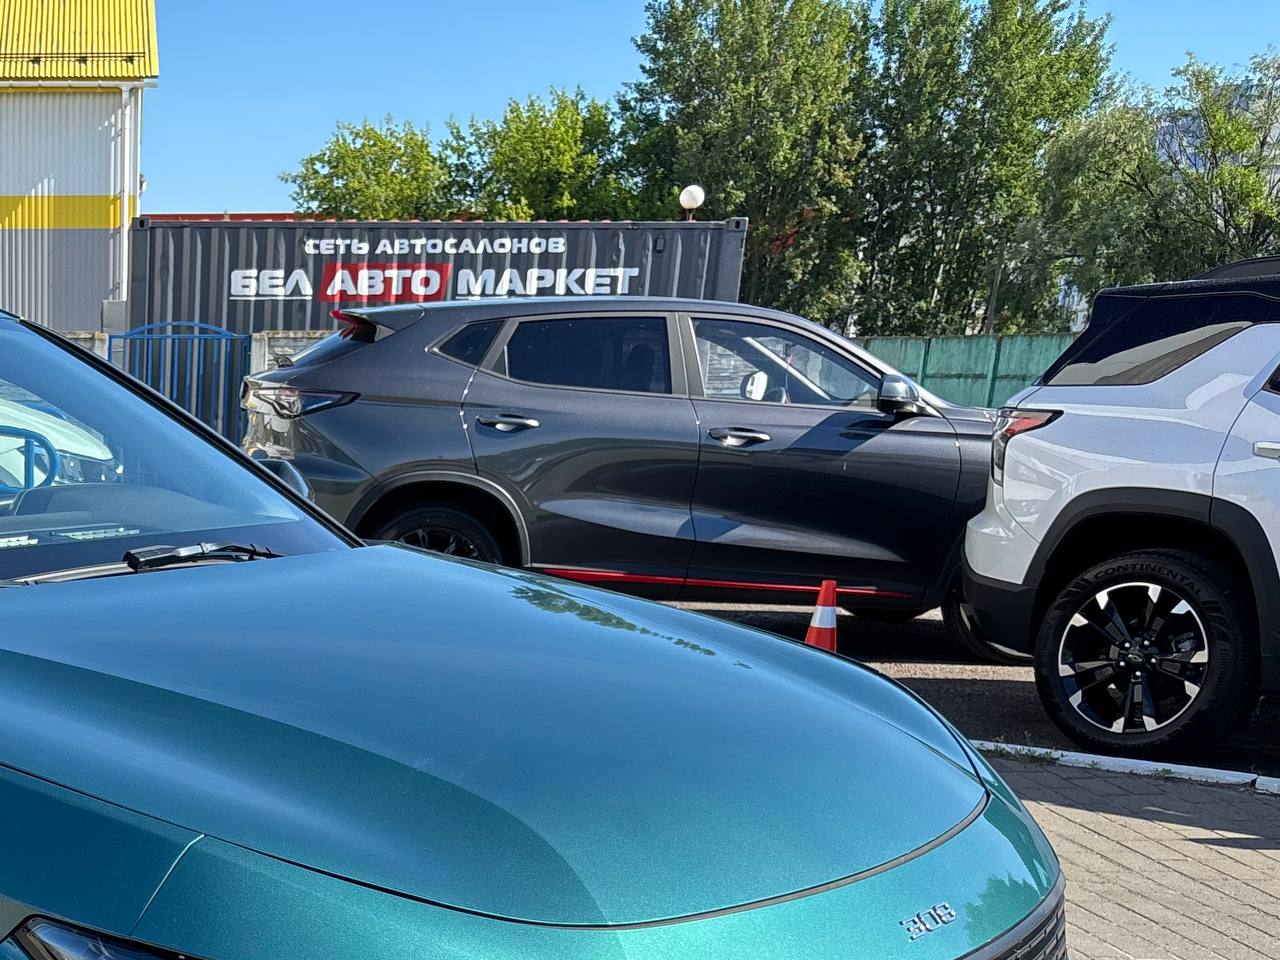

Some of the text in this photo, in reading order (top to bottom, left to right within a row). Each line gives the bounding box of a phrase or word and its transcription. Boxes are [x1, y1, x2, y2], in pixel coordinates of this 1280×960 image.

[304, 238, 567, 254] СЕТЬ АВТОСАЛОНОВ
[229, 267, 639, 296] БЕЛ АВТО МАРКЕТ
[899, 901, 957, 940] 308
